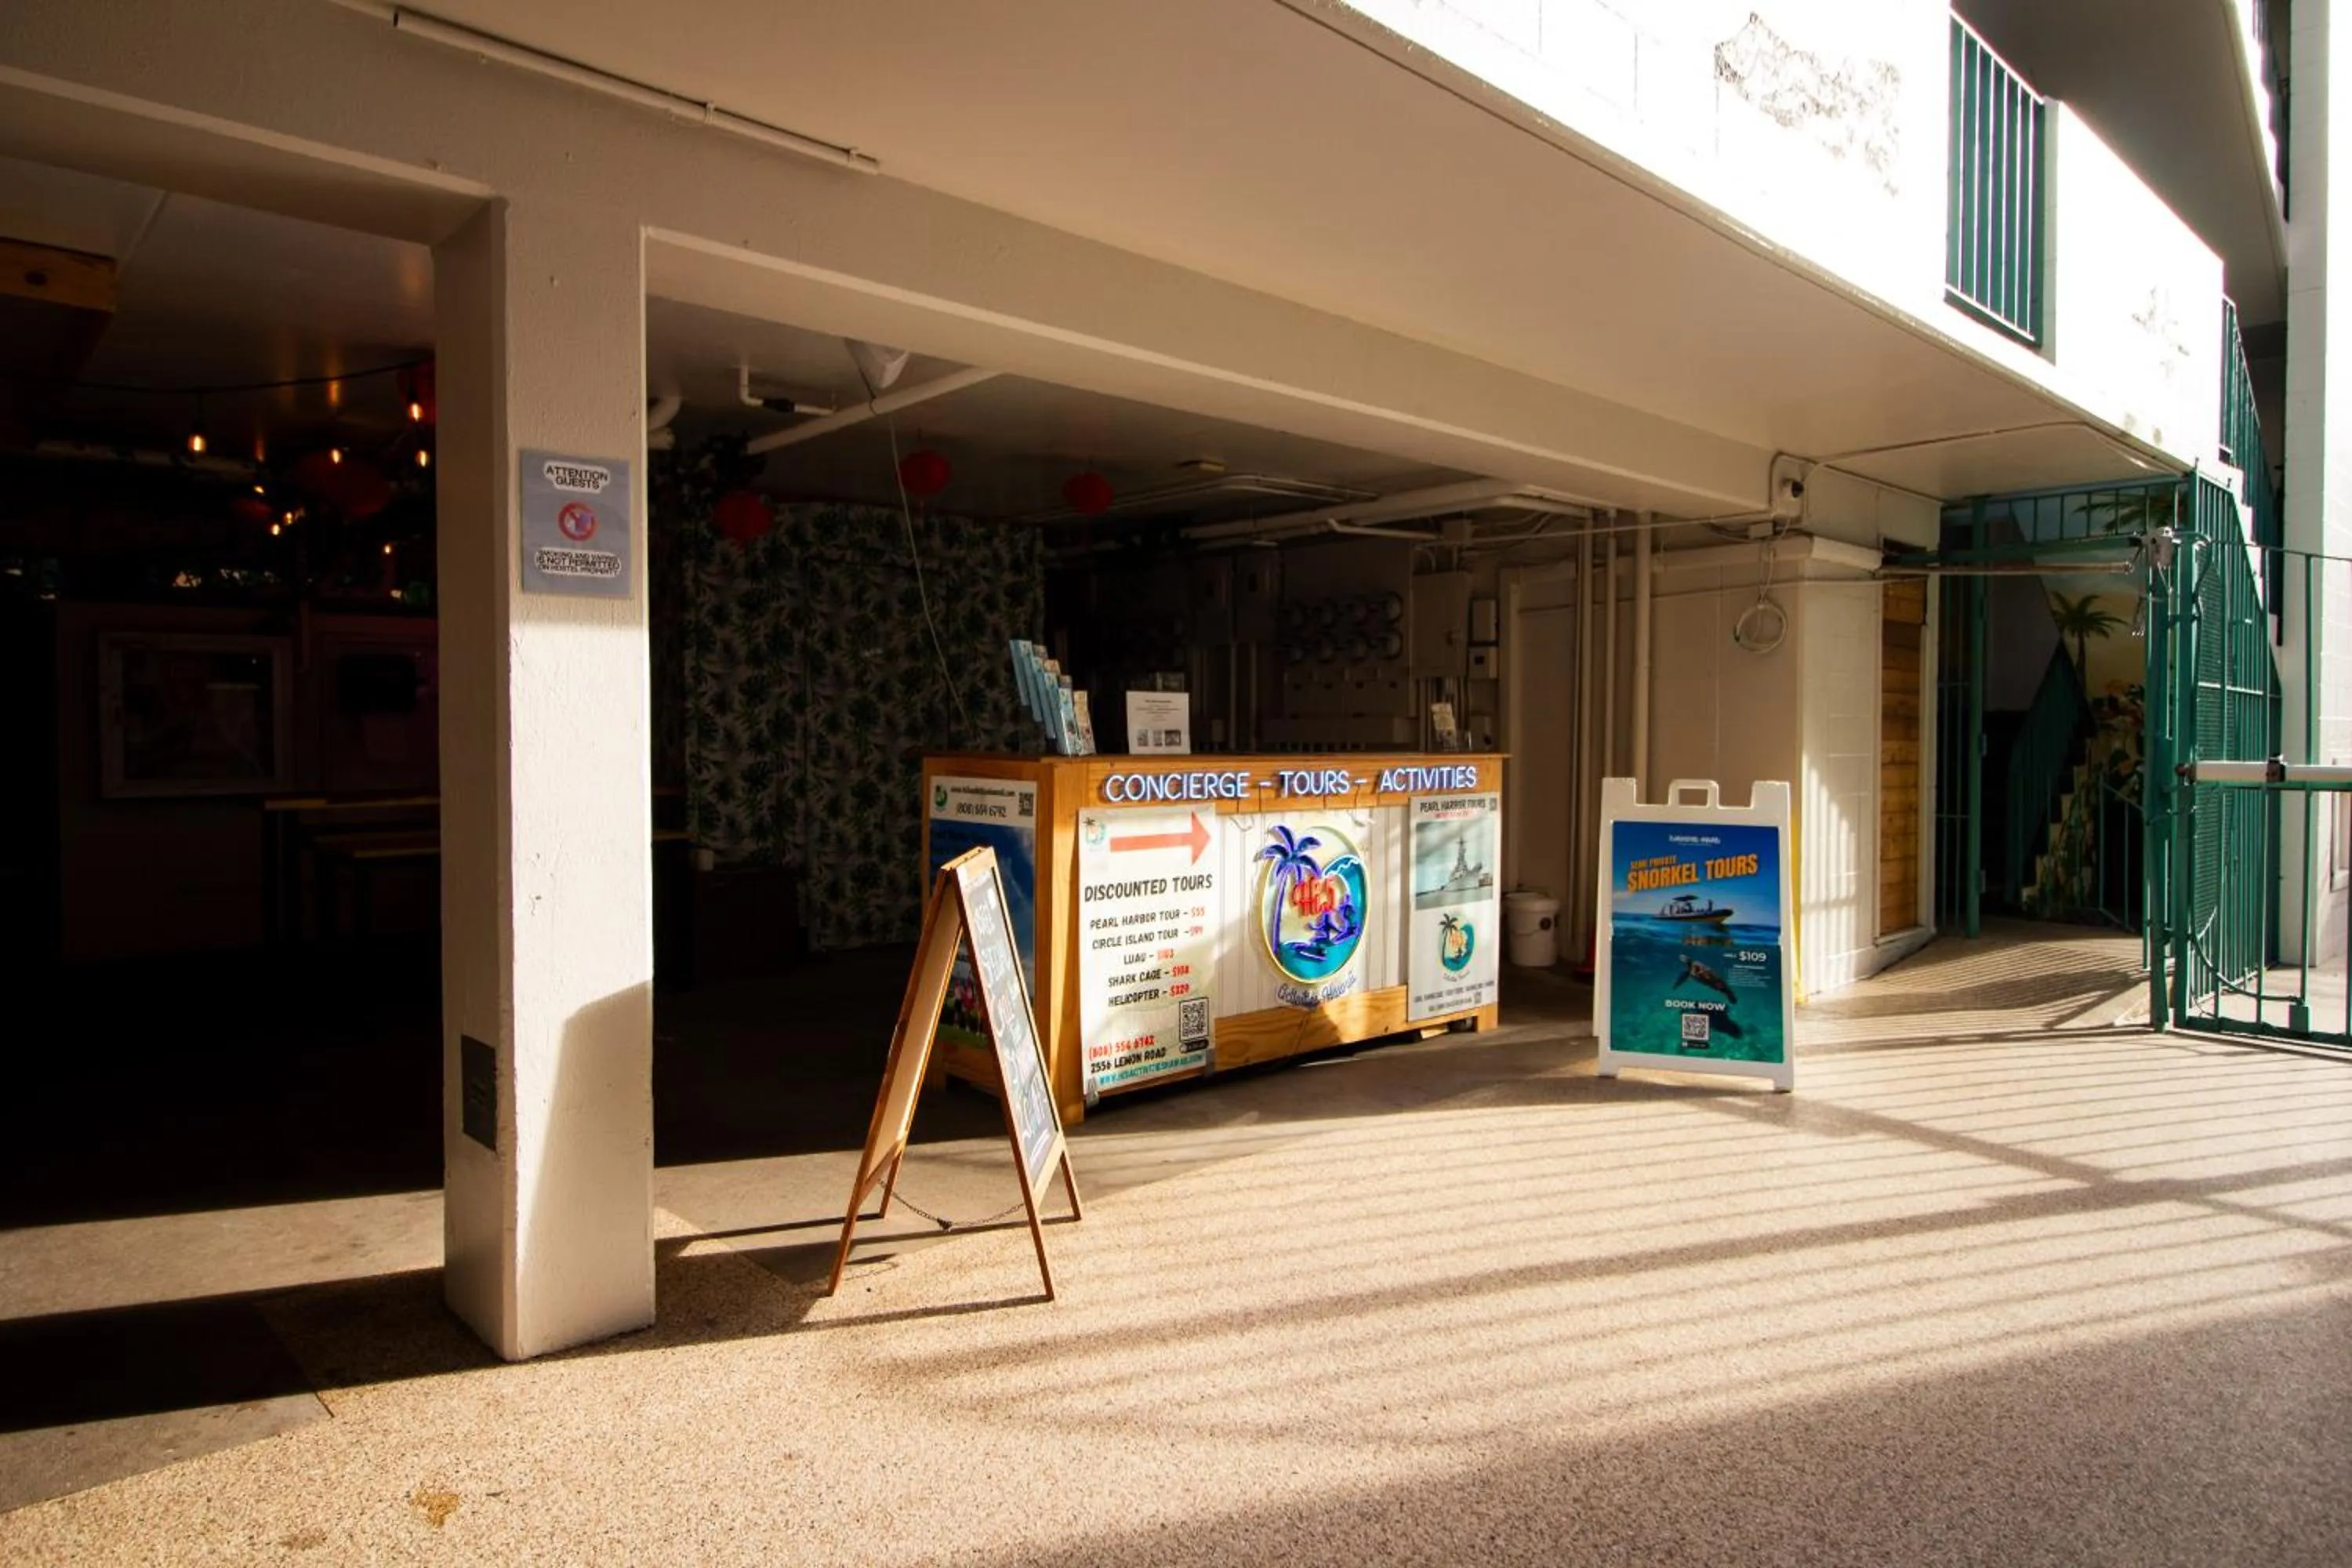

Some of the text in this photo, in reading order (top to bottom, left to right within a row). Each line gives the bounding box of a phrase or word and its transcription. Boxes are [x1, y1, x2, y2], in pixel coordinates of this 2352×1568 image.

[546, 465, 608, 481] ATTENTION
[556, 476, 600, 490] GUESTS
[546, 556, 565, 565] NOT
[568, 557, 620, 569] PERMITTED
[1105, 771, 1250, 802] CONCIERGE
[1279, 769, 1351, 797] TOURS
[1377, 765, 1477, 793] ACTIVITIES
[1420, 801, 1439, 813] PEARL
[1627, 852, 1759, 895] SNORKEL TOURS
[1084, 873, 1213, 902] DISCOUNTED TOURS
[1090, 916, 1119, 930] PEARL
[1122, 912, 1156, 926] HARBOR
[1160, 909, 1180, 921] TOUR
[1091, 935, 1123, 950] CIRCLE
[1125, 932, 1155, 946] ISLAND
[1157, 928, 1179, 941] TOUR
[1123, 953, 1147, 965] LUAU
[1738, 950, 1767, 962] $109
[1108, 974, 1137, 988] SHARK
[1139, 968, 1162, 983] CAGE
[1108, 989, 1160, 1007] HELICOPTER
[1664, 999, 1726, 1011] BOOK NOW
[1088, 1042, 1112, 1062] (808)
[1114, 1052, 1142, 1069] LEMON
[1144, 1047, 1167, 1061] ROAD
